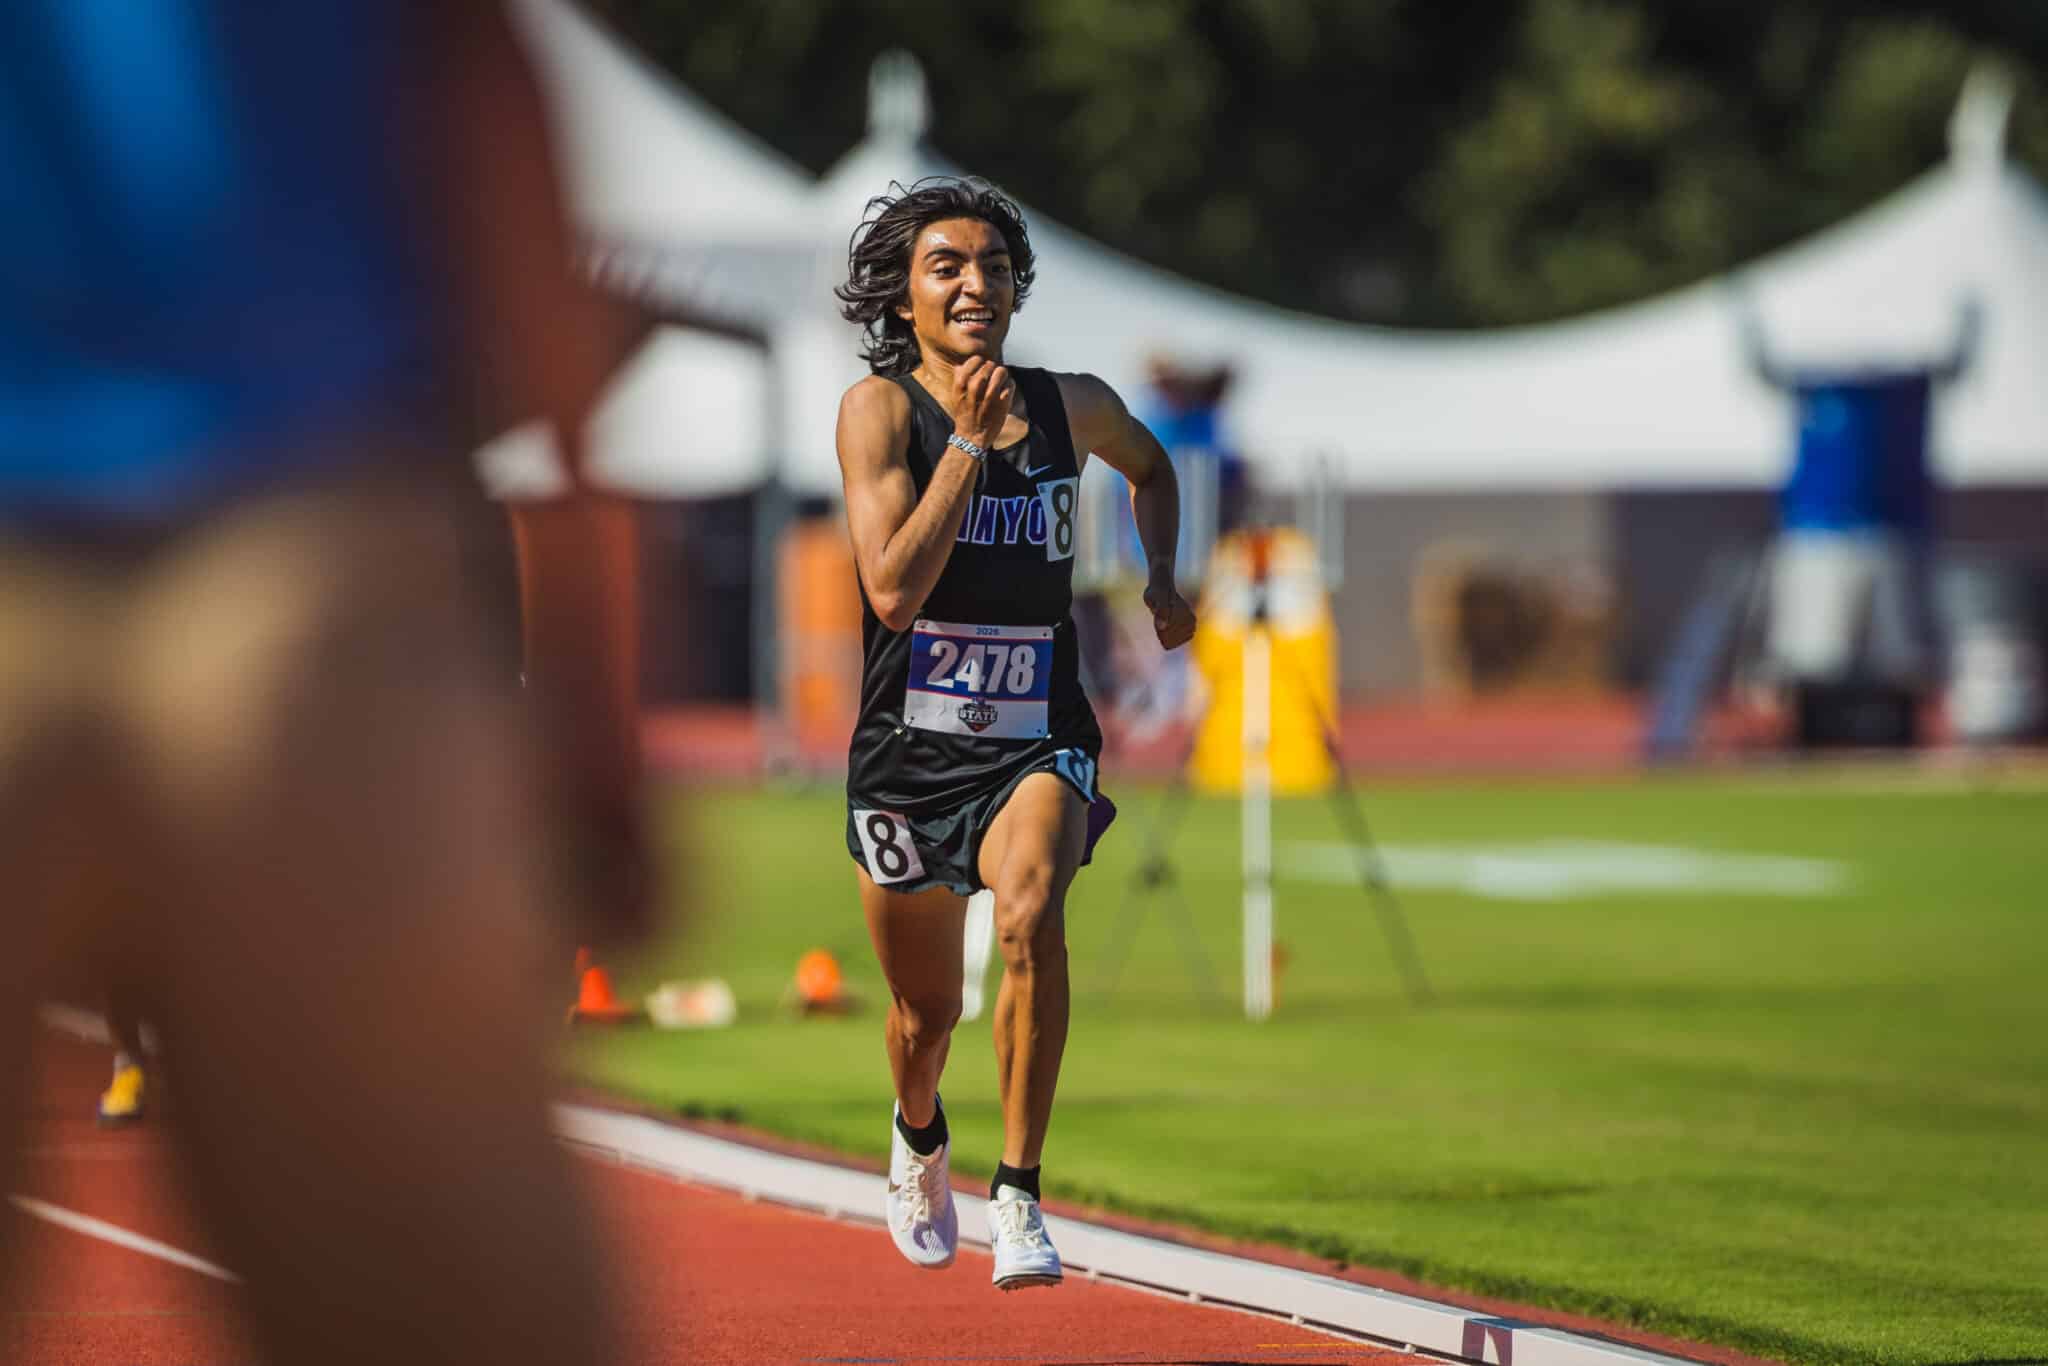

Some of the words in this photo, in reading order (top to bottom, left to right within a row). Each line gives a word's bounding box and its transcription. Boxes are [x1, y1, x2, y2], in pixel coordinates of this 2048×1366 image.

[1052, 483, 1073, 554] 8
[926, 640, 1036, 694] 2478
[959, 708, 997, 721] STATE
[866, 813, 909, 877] 8
